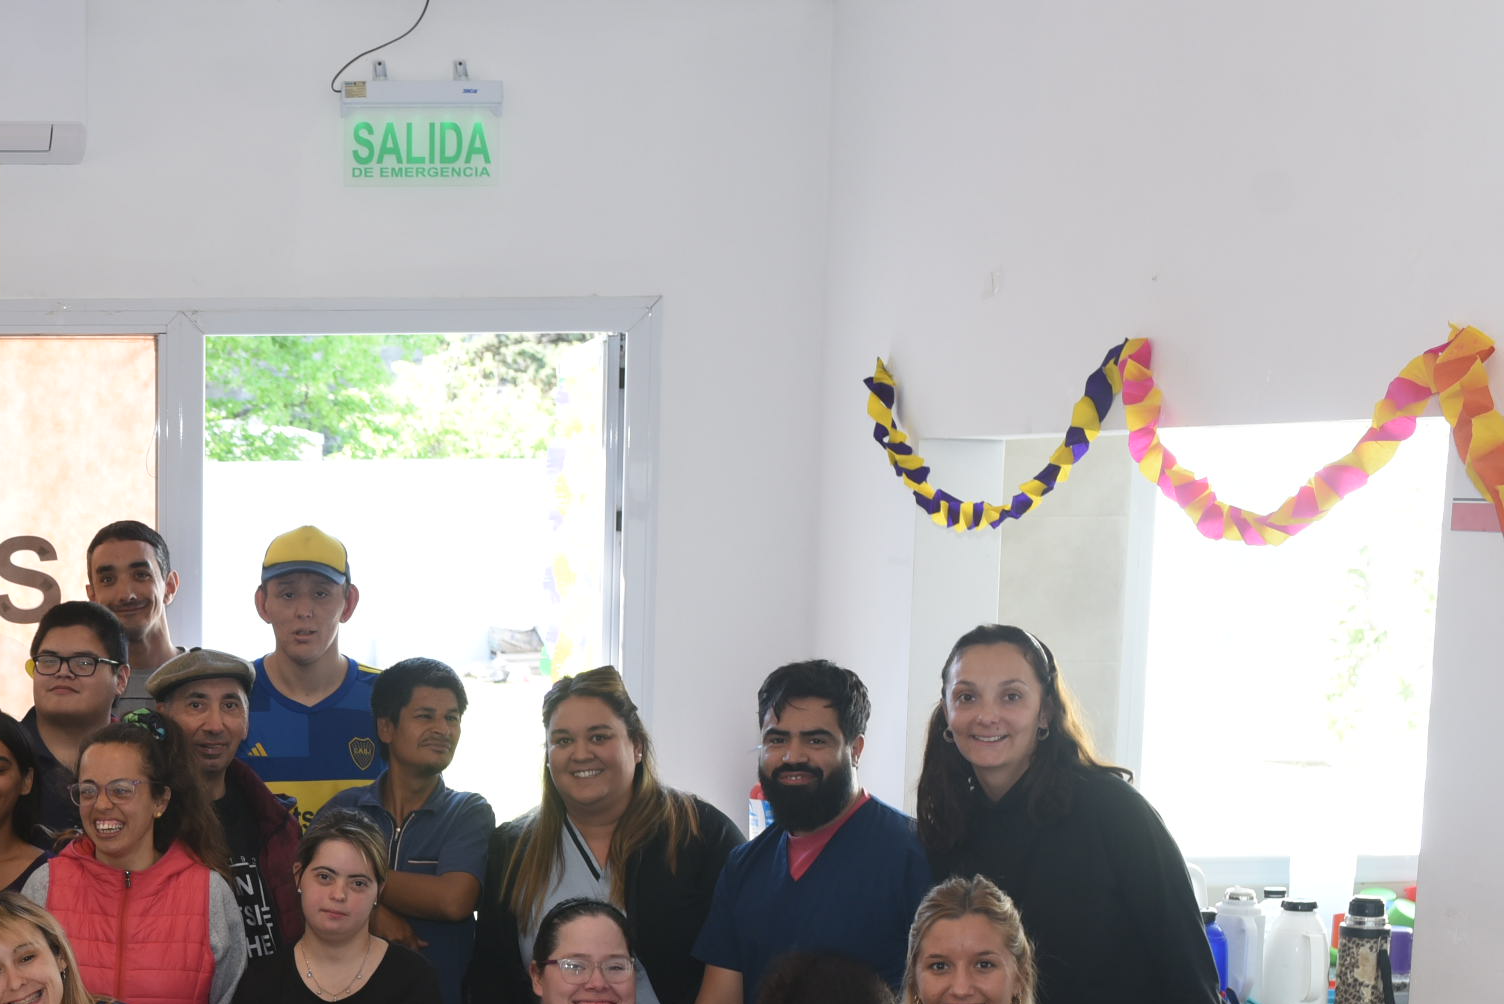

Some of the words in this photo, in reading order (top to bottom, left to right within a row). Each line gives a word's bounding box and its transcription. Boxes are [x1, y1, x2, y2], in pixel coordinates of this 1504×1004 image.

[352, 121, 492, 165] SALIDA
[352, 167, 374, 178] DE
[380, 166, 491, 178] EMERGENCIA
